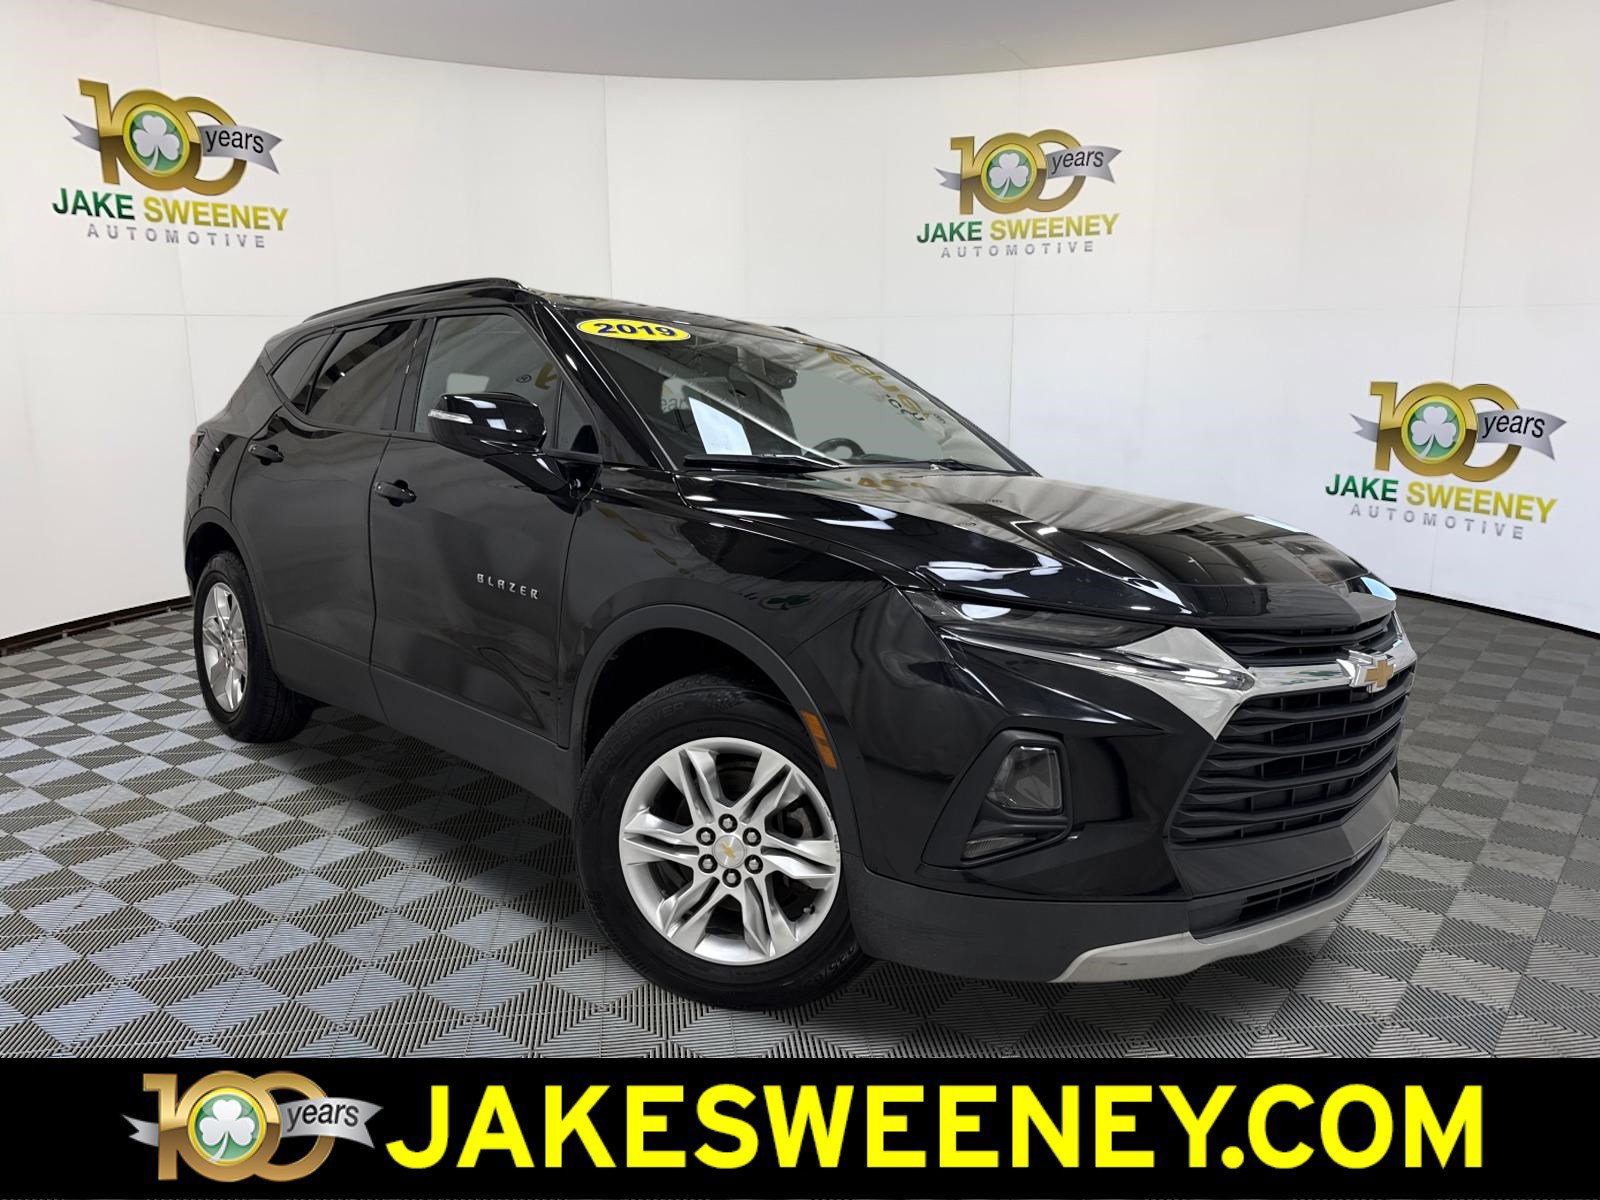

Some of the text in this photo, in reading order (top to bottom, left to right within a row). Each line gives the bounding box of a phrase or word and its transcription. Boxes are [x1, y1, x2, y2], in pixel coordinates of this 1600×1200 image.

[204, 129, 265, 154] years
[1050, 149, 1104, 174] years
[52, 188, 288, 231] JAKE SWEENEY
[87, 223, 265, 248] AUTOMOTIVE
[916, 212, 1120, 243] JAKE SWEENEY
[940, 240, 1094, 258] AUTOMOTIVE
[593, 322, 678, 337] 2019
[1481, 414, 1545, 438] years
[1325, 473, 1557, 523] JAKE SWEENEY
[1350, 503, 1524, 540] AUTOMOTIVE
[476, 573, 538, 600] BLAZER
